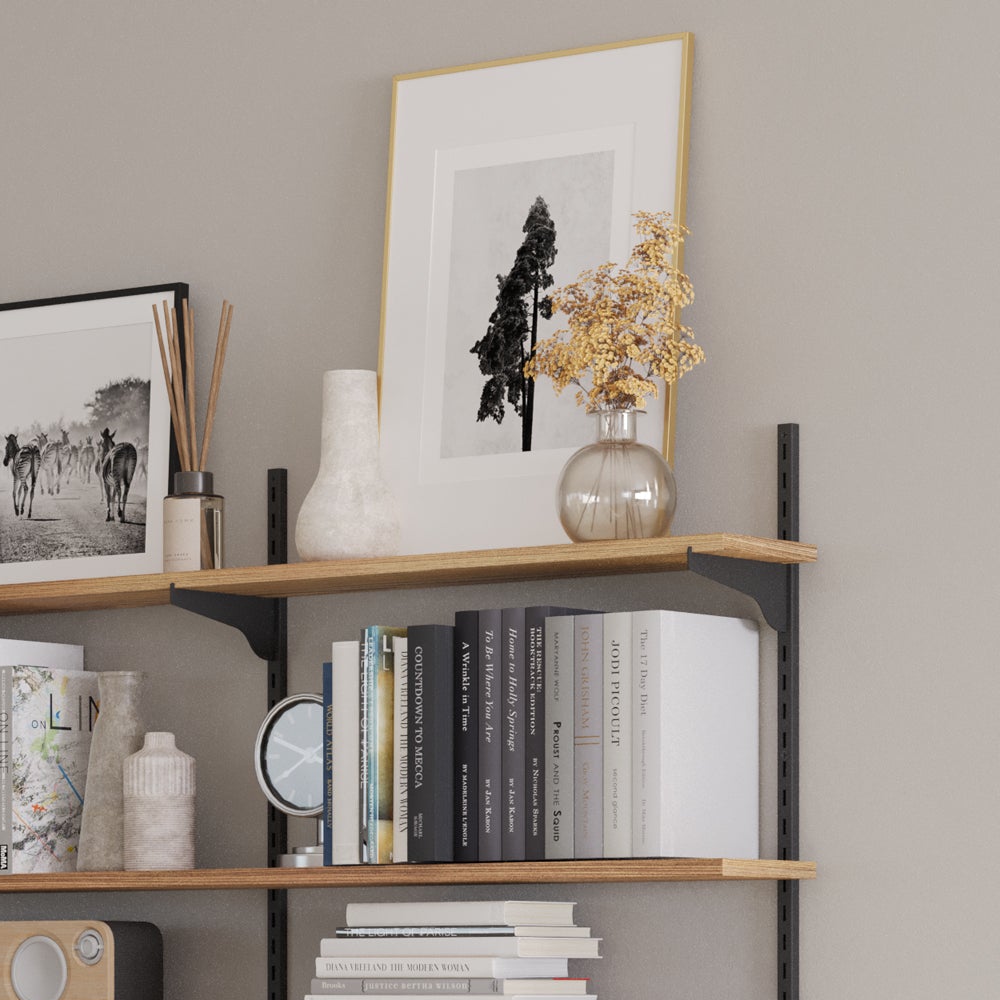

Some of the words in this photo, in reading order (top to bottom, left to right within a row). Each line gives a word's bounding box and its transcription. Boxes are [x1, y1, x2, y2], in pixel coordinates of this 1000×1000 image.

[484, 630, 493, 642] To
[509, 628, 517, 659] Home
[580, 626, 589, 664] JOHN
[639, 630, 648, 650] The
[484, 646, 493, 660] Be
[610, 640, 620, 674] JODI
[639, 654, 648, 666] 17
[399, 651, 407, 679] DIANA
[509, 663, 516, 672] to
[414, 646, 423, 725] COUNTDOWN
[484, 663, 493, 697] Where
[639, 669, 648, 690] Day
[462, 695, 469, 704] in
[507, 676, 517, 706] Holly
[580, 667, 589, 728] GRISHAM
[484, 700, 493, 719] You
[610, 681, 620, 746] PICOULT
[639, 694, 648, 716] Diet
[32, 720, 46, 729] ON
[484, 724, 493, 743] Are
[507, 709, 517, 752] Springs
[399, 734, 407, 752] THE
[414, 727, 423, 743] TO
[553, 722, 562, 758] PROUST
[414, 746, 423, 788] MECCA
[462, 764, 468, 773] BY
[532, 758, 538, 767] BY
[399, 755, 407, 795] MODERN
[485, 779, 491, 788] BY
[508, 778, 515, 787] BY
[553, 764, 562, 786] AND
[553, 789, 562, 805] THE
[399, 799, 407, 833] WOMAN
[553, 811, 562, 842] SQUID
[346, 928, 365, 937] THE
[368, 928, 399, 937] LIGHT
[401, 928, 414, 937] OF
[326, 963, 348, 971] DIANA
[391, 963, 404, 971] THE
[407, 963, 439, 971] MODERN
[442, 963, 470, 971] WOMAN
